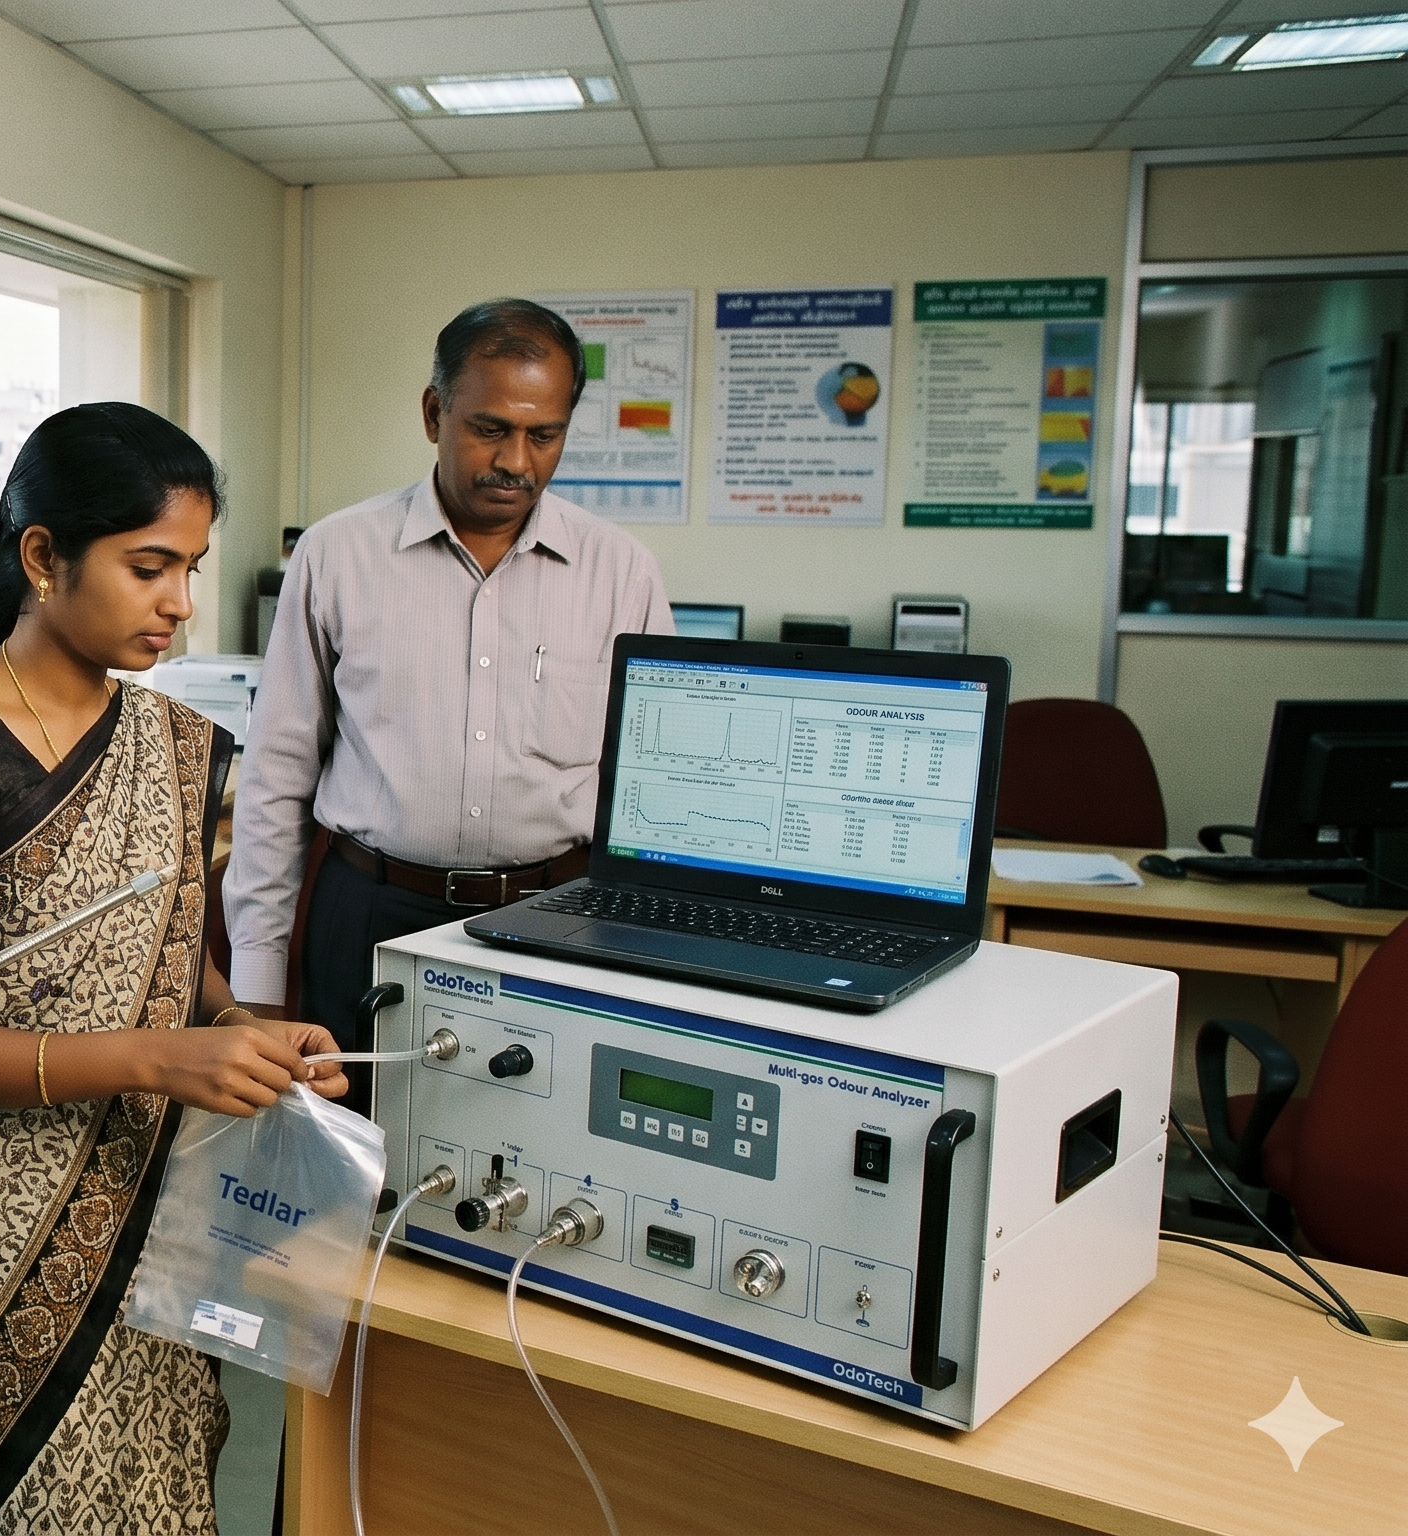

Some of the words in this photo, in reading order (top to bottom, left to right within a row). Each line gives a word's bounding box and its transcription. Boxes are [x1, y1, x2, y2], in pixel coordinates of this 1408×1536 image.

[846, 708, 878, 717] ODOUR
[880, 711, 925, 721] ANALYSIS
[424, 969, 493, 997] OdoTech
[828, 1077, 868, 1095] Odour
[872, 1087, 930, 1109] Analyzer
[833, 1363, 903, 1396] OdoTech
